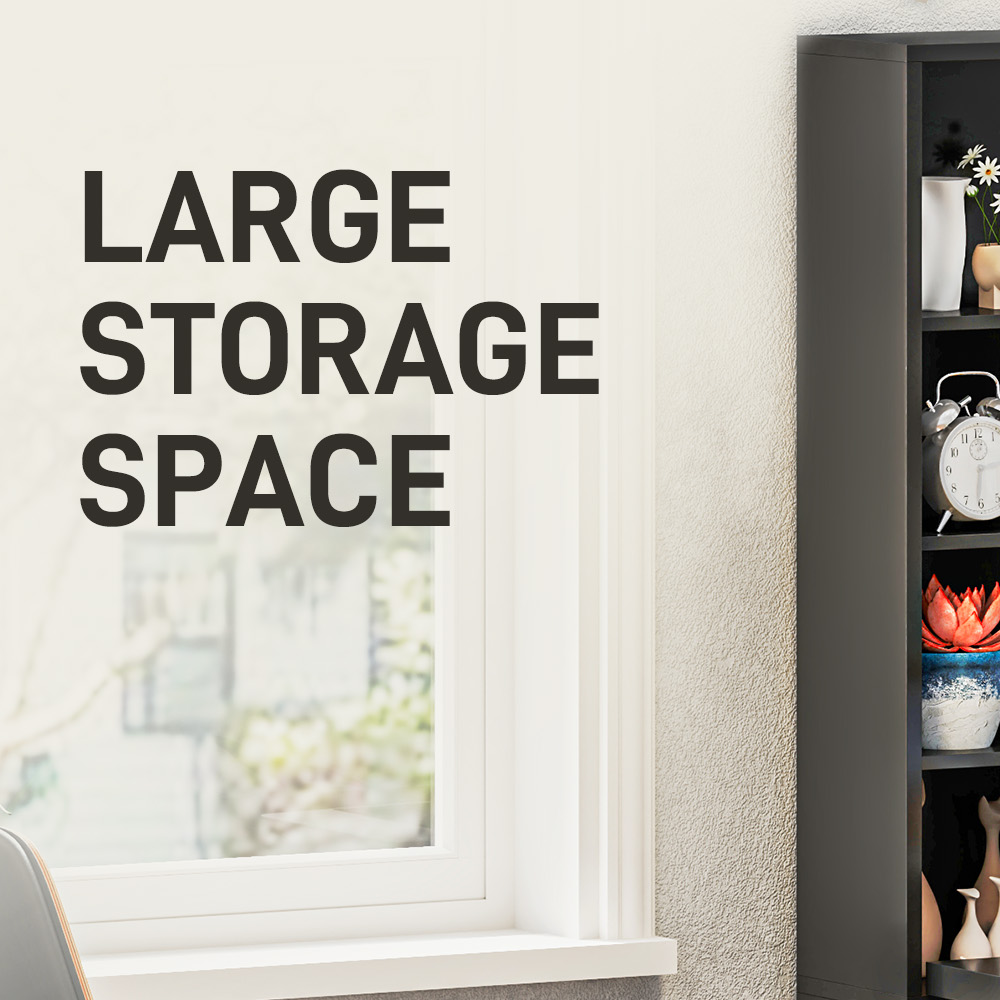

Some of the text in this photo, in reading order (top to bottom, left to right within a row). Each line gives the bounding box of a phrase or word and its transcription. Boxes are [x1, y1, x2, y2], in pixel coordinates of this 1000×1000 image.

[974, 428, 982, 438] 12
[961, 434, 968, 444] 11
[950, 448, 959, 457] 10
[946, 466, 952, 476] 9
[951, 483, 957, 492] 8
[962, 495, 969, 506] 7
[995, 493, 1000, 503] 5
[978, 498, 984, 509] 6
